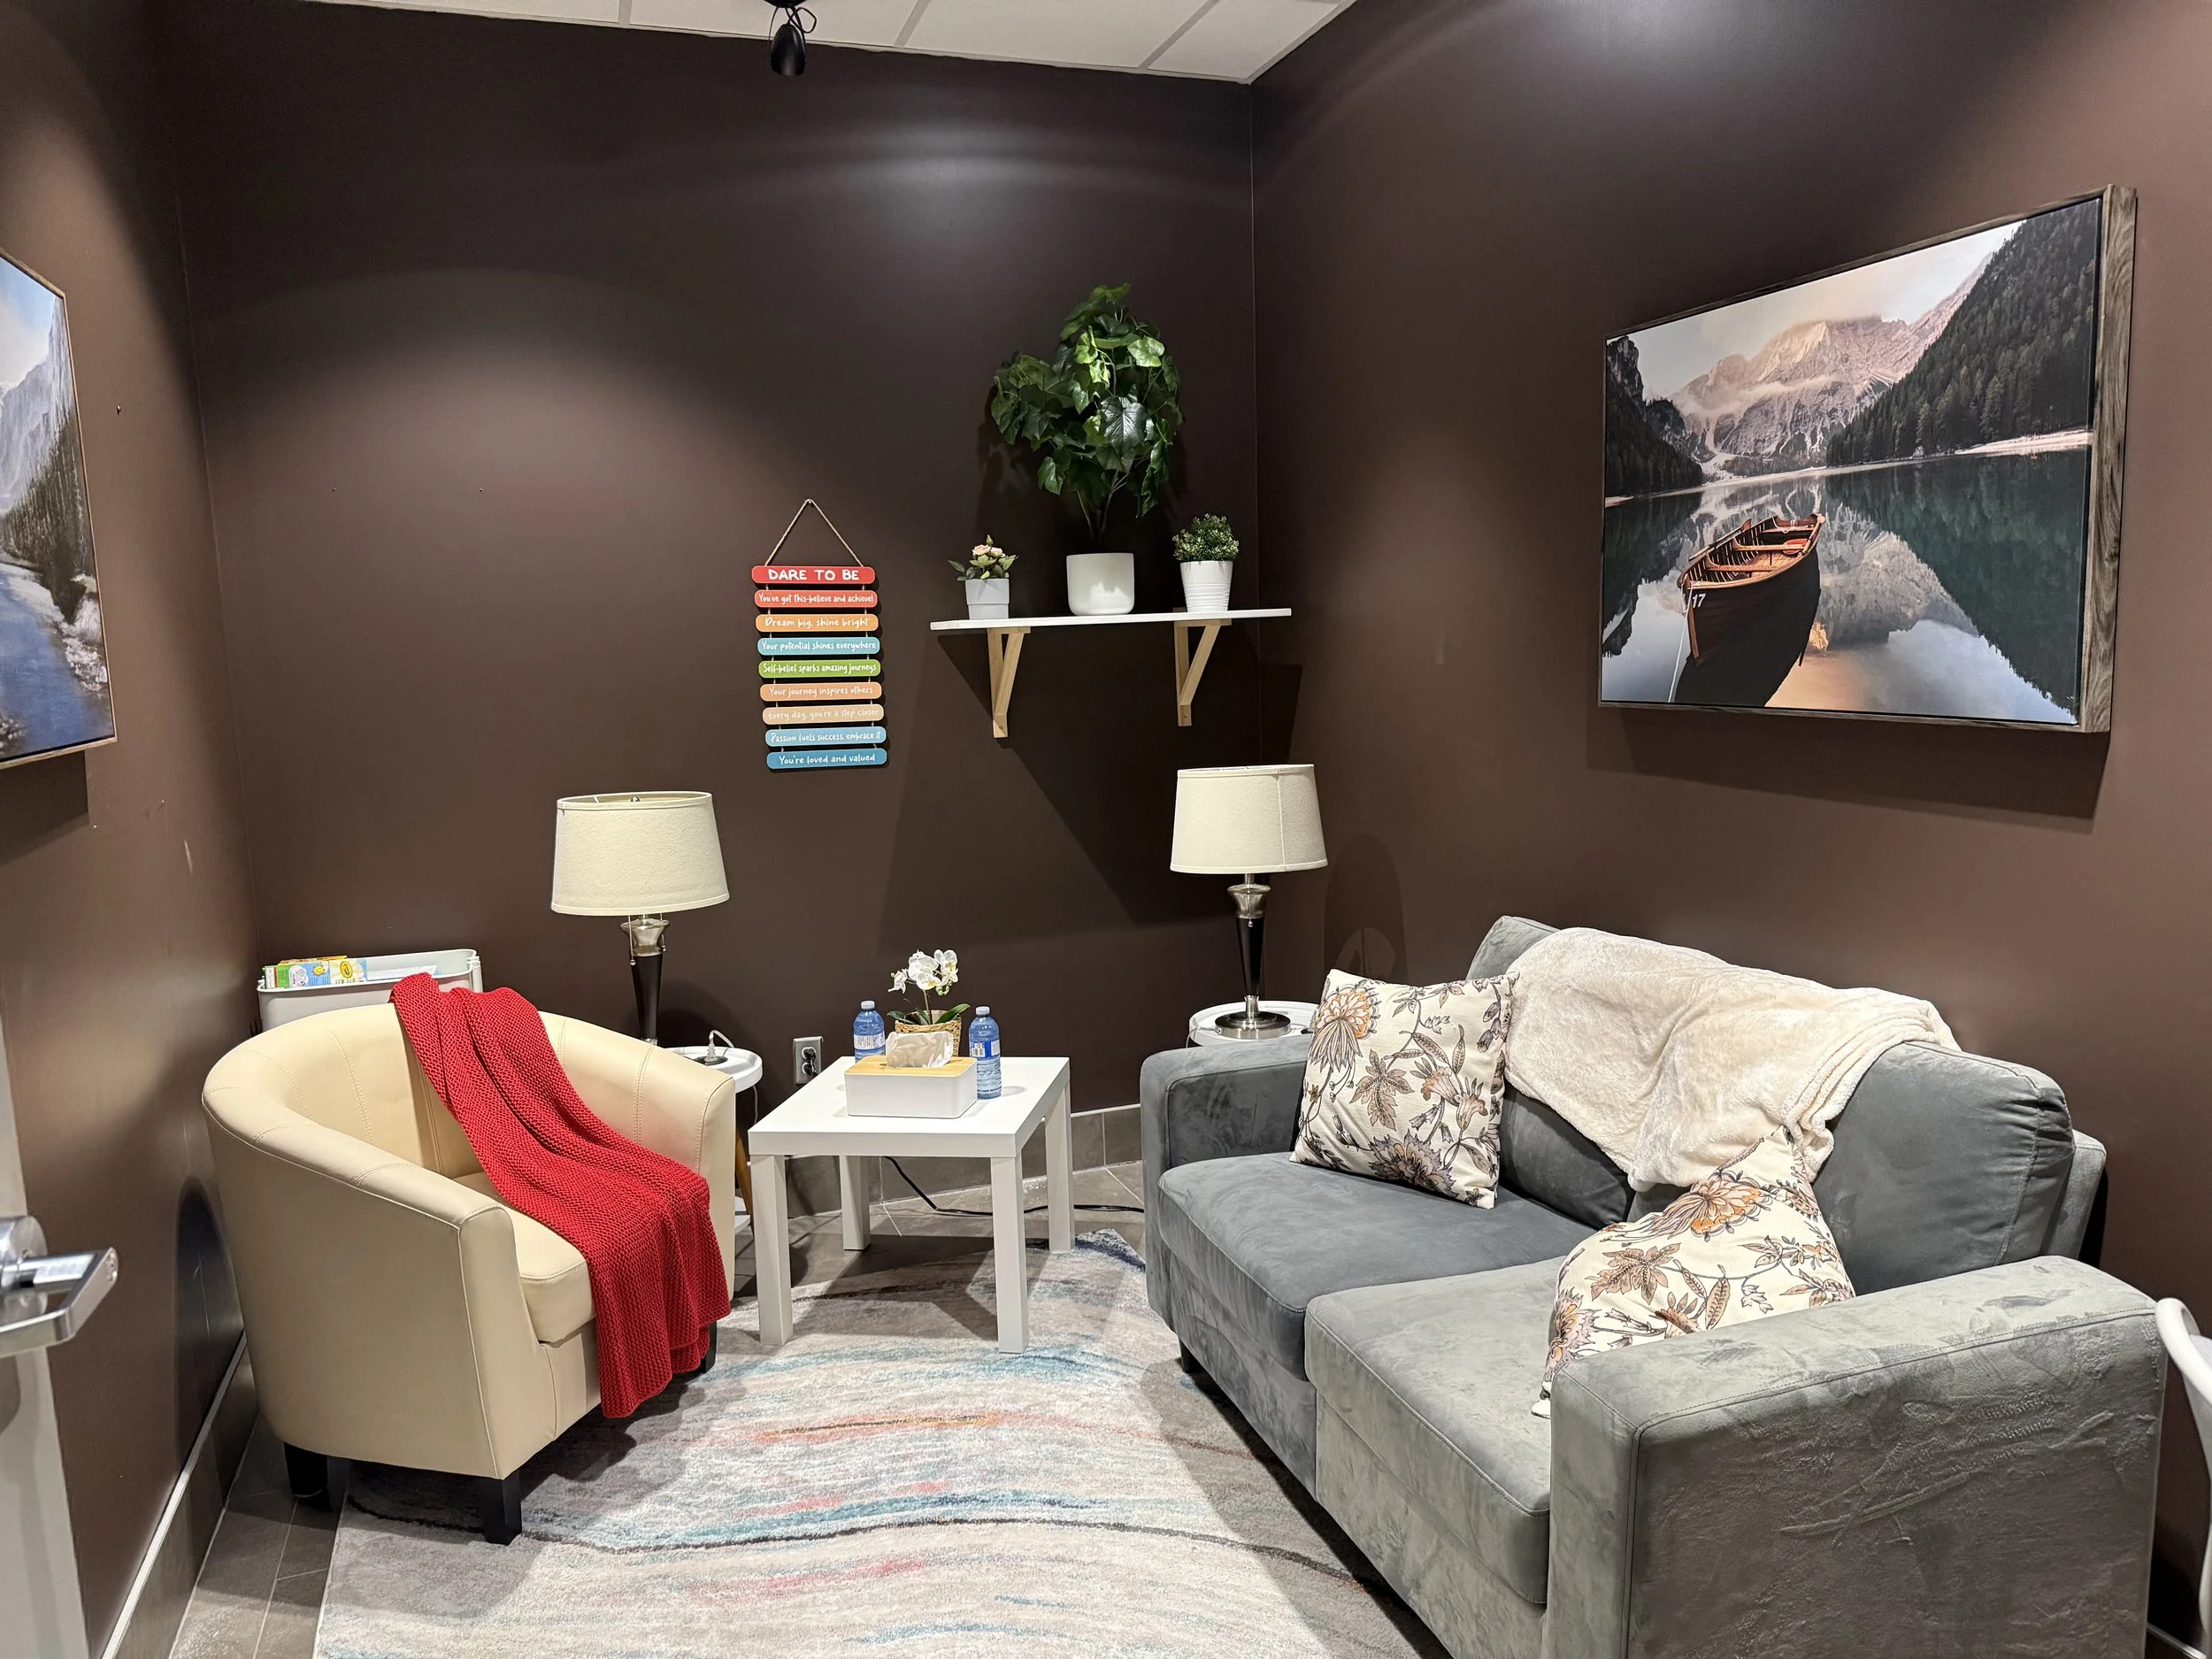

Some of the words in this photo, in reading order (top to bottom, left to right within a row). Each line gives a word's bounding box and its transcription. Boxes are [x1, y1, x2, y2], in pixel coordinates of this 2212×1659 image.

[768, 569, 807, 580] DARE
[814, 570, 836, 580] TO
[842, 570, 859, 580] BE
[759, 593, 779, 602] You've
[781, 595, 792, 604] got
[1692, 593, 1706, 608] 17
[764, 618, 794, 626] Dream
[817, 618, 839, 626] shine
[842, 618, 869, 628] bright
[762, 641, 778, 649] Your
[780, 641, 810, 651] potential
[836, 641, 876, 651] everywhere
[764, 664, 796, 673] Self-belief
[799, 664, 819, 673] sparks
[848, 664, 876, 674] journeys
[769, 687, 786, 695] Your
[787, 687, 818, 698] journey
[819, 687, 849, 695] inspires
[768, 711, 789, 720] Every
[810, 710, 832, 720] you're
[771, 733, 796, 742] Passion
[799, 733, 816, 742] fuels
[875, 731, 881, 740] it
[779, 755, 804, 764] You're
[807, 755, 828, 764] loved
